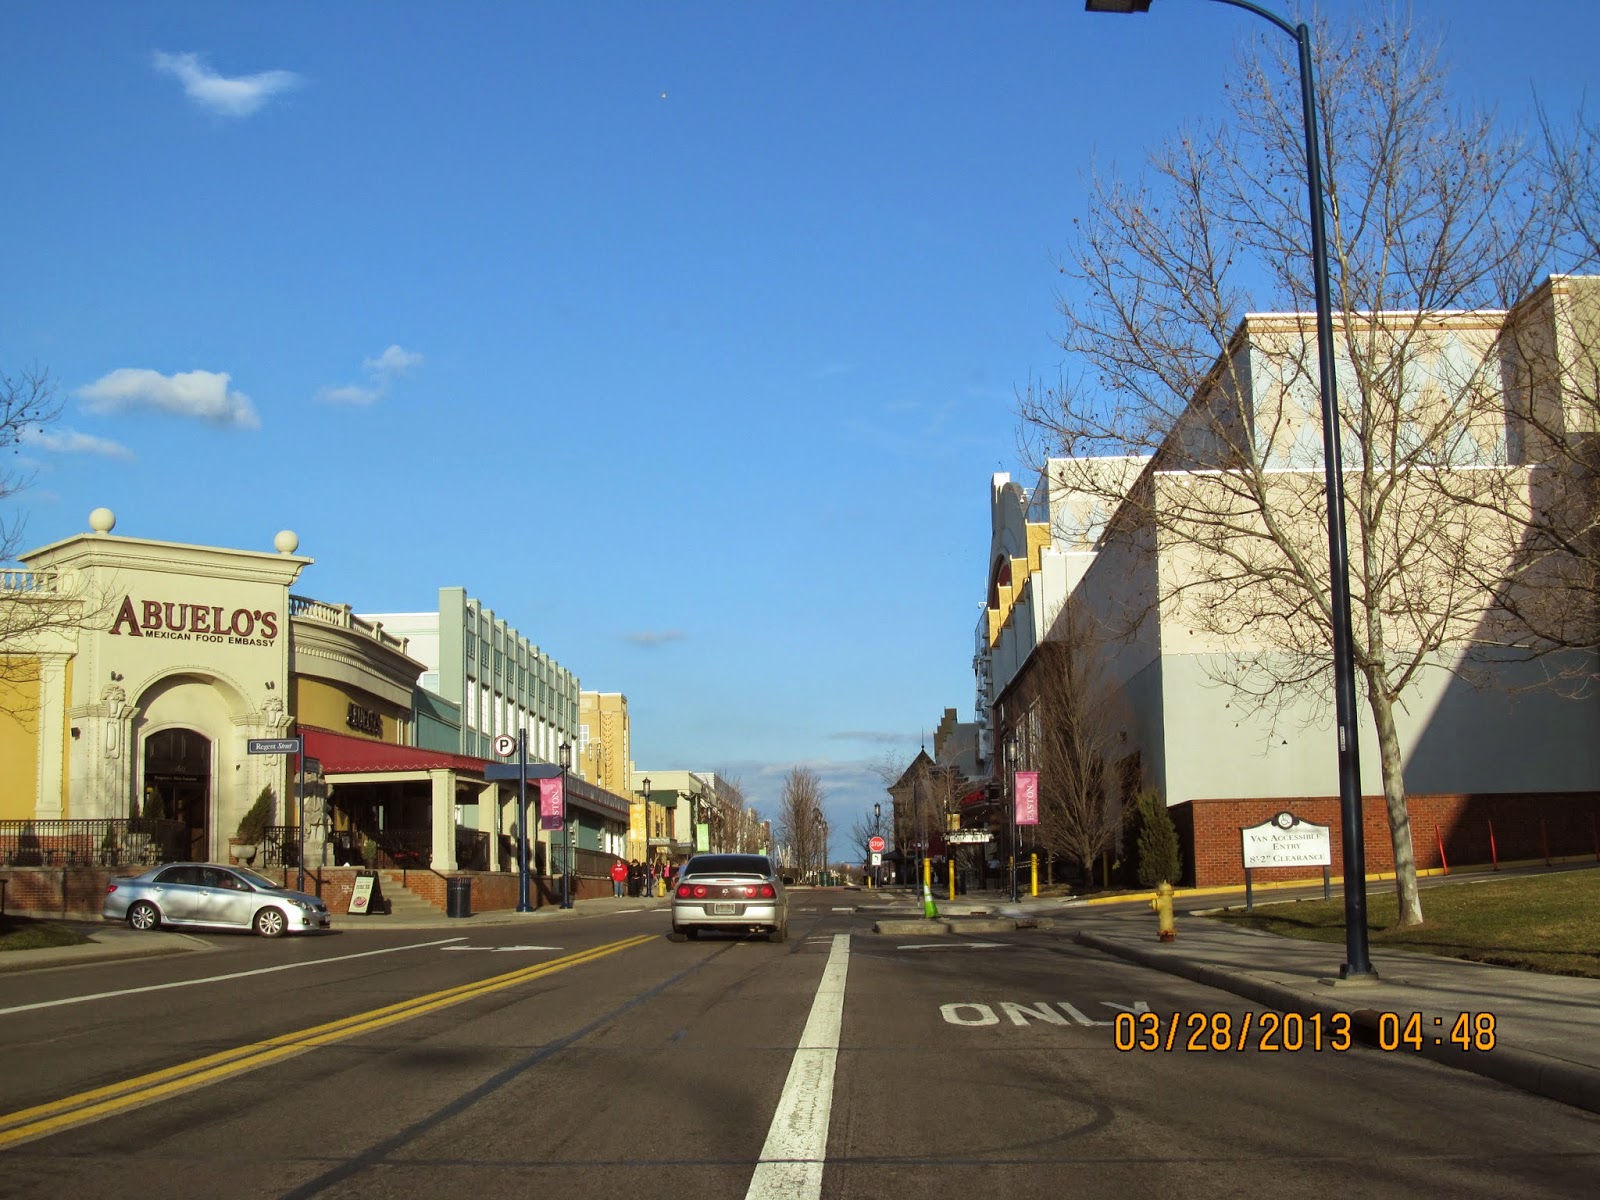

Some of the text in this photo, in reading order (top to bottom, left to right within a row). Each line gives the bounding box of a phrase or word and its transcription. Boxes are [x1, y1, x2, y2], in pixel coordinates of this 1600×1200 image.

[108, 595, 278, 639] ABUELO'S
[145, 631, 275, 648] MEXICAN FOOD EMBASSY
[255, 742, 293, 751] Regent Street
[500, 739, 509, 752] P
[552, 790, 560, 827] EASTON
[1027, 784, 1035, 821] EASTON
[1250, 833, 1322, 843] VAN ACCESSIBLE
[1272, 843, 1302, 851] ENTRY
[1273, 853, 1326, 863] CLEARANCE
